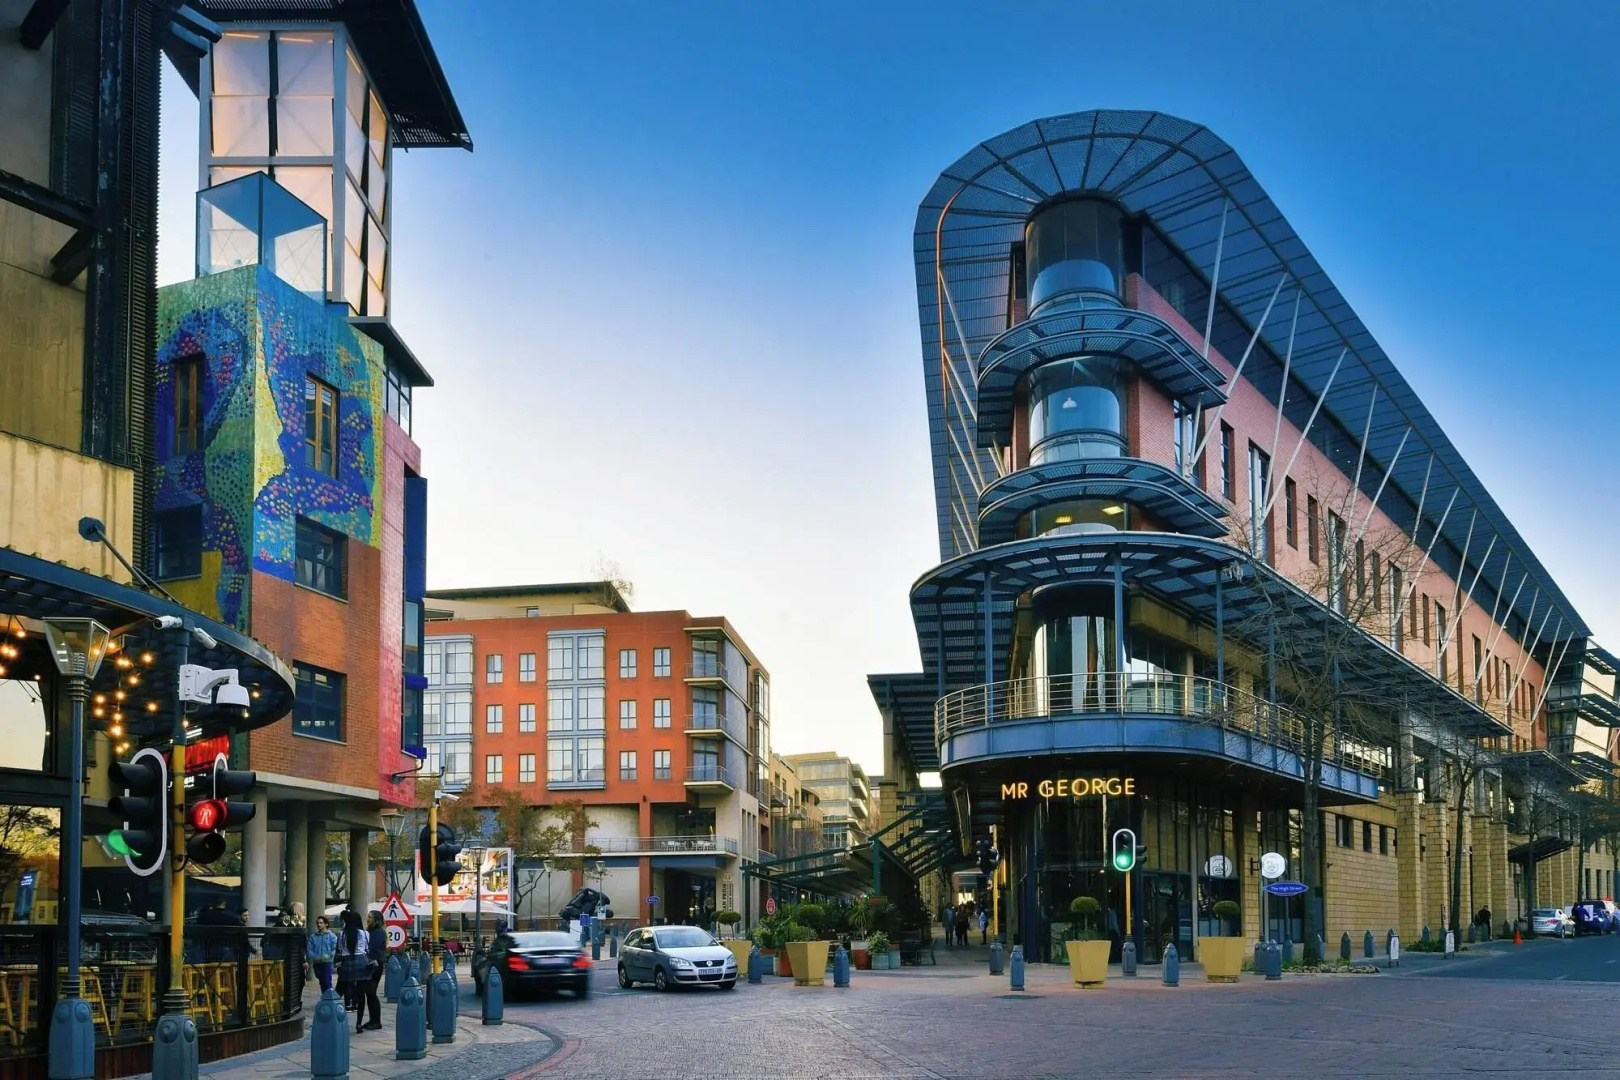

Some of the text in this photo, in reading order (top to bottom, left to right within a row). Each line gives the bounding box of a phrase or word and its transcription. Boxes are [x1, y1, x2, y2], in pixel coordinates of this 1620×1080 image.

[1001, 777, 1136, 800] MR GEORGE
[388, 931, 401, 942] 20
